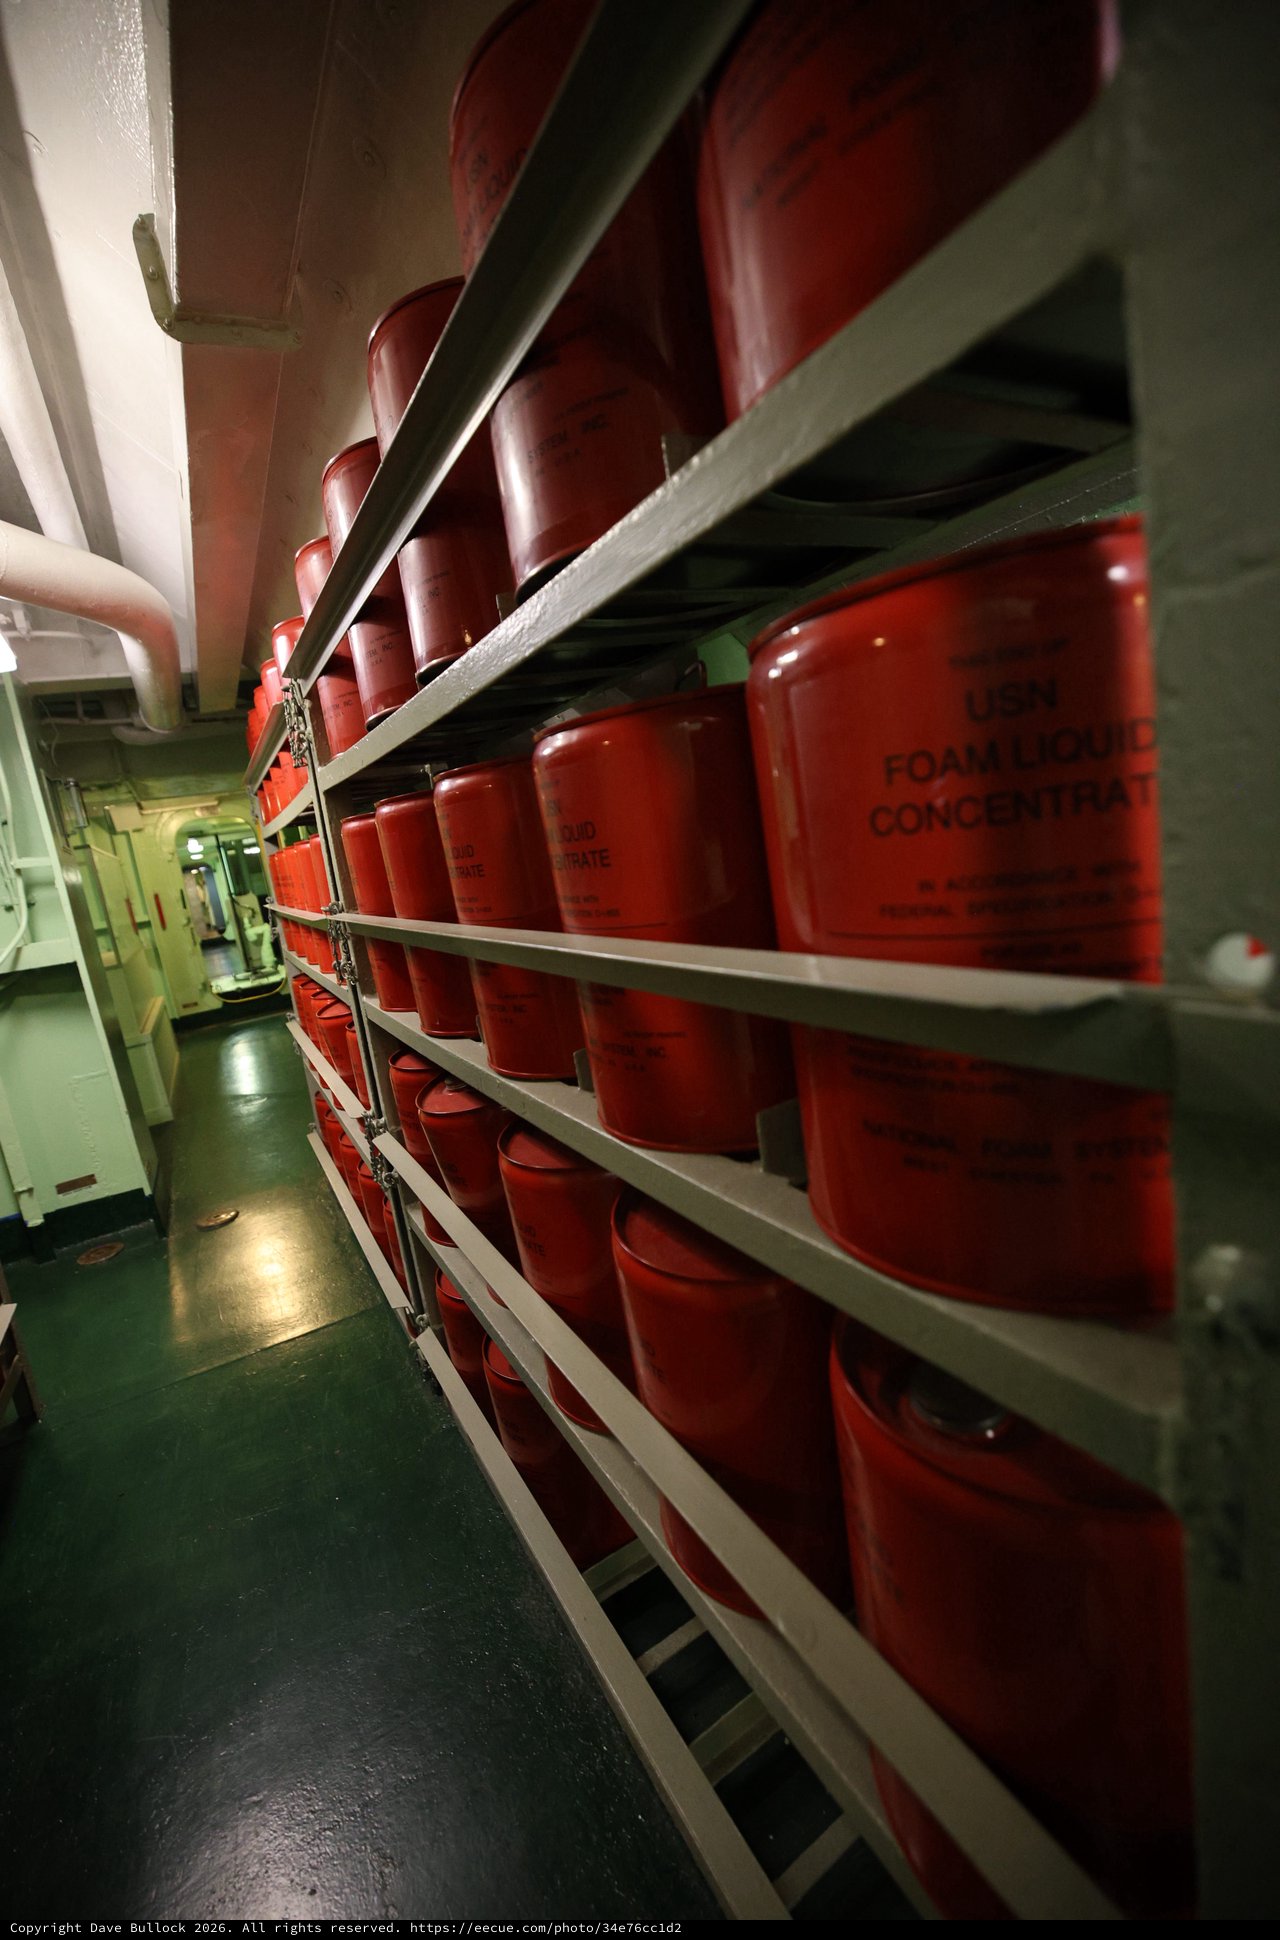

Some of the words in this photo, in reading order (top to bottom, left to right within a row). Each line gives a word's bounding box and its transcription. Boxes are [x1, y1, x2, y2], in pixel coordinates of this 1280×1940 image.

[965, 676, 1057, 722] USN
[882, 739, 1002, 787] FOAM
[1011, 716, 1157, 770] LIQUID
[867, 773, 1159, 839] CONCENTRAT
